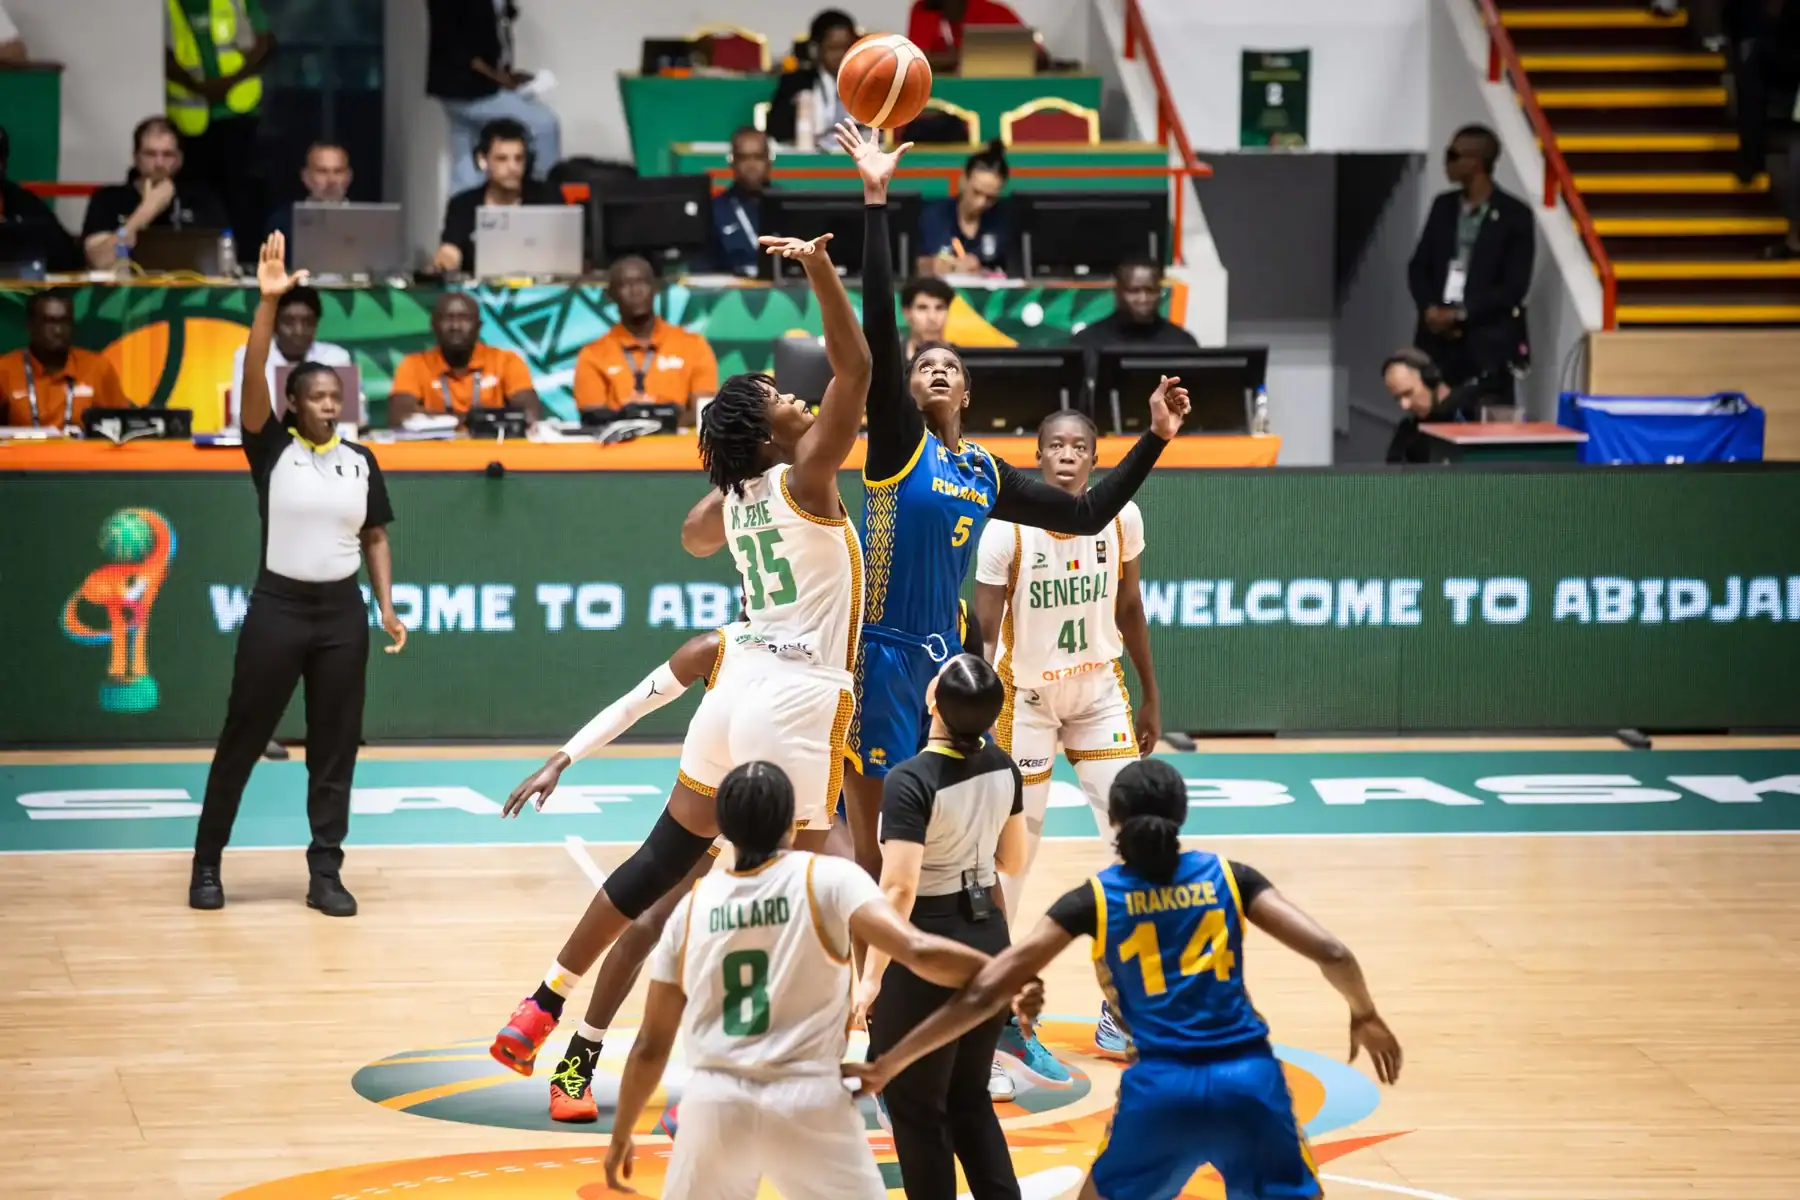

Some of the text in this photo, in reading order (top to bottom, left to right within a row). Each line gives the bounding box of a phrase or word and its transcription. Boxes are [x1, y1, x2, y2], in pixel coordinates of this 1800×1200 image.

[951, 516, 973, 547] 5
[736, 528, 797, 610] 35
[1030, 571, 1107, 609] SENEGAL
[209, 583, 516, 632] WOME
[535, 582, 624, 631] TO
[1139, 577, 1424, 628] WELCOME
[1438, 576, 1527, 625] TO
[1057, 617, 1088, 654] 41
[709, 896, 789, 933] DILLARD
[1125, 881, 1218, 916] IRAKOZE
[1118, 907, 1235, 997] 14
[722, 950, 770, 1036] 8
